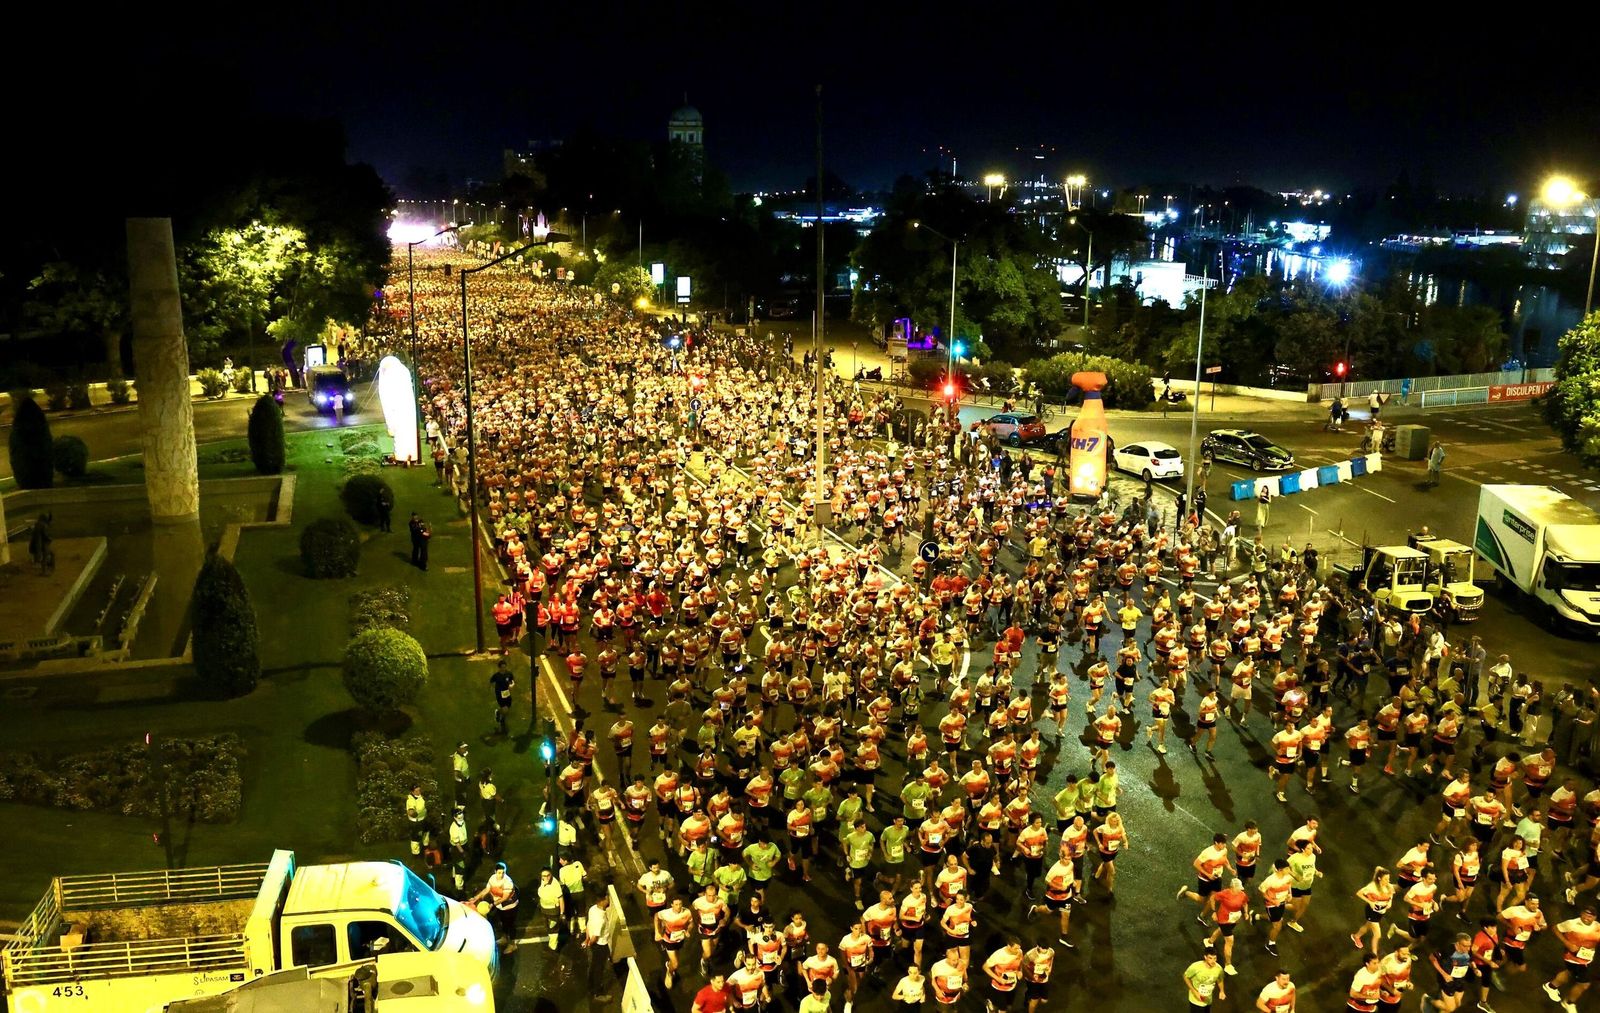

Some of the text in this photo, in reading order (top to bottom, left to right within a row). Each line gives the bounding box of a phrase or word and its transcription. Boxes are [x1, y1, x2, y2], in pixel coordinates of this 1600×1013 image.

[1506, 385, 1541, 397] DISCULPEN
[1504, 514, 1535, 540] enterprise
[53, 985, 84, 998] 453
